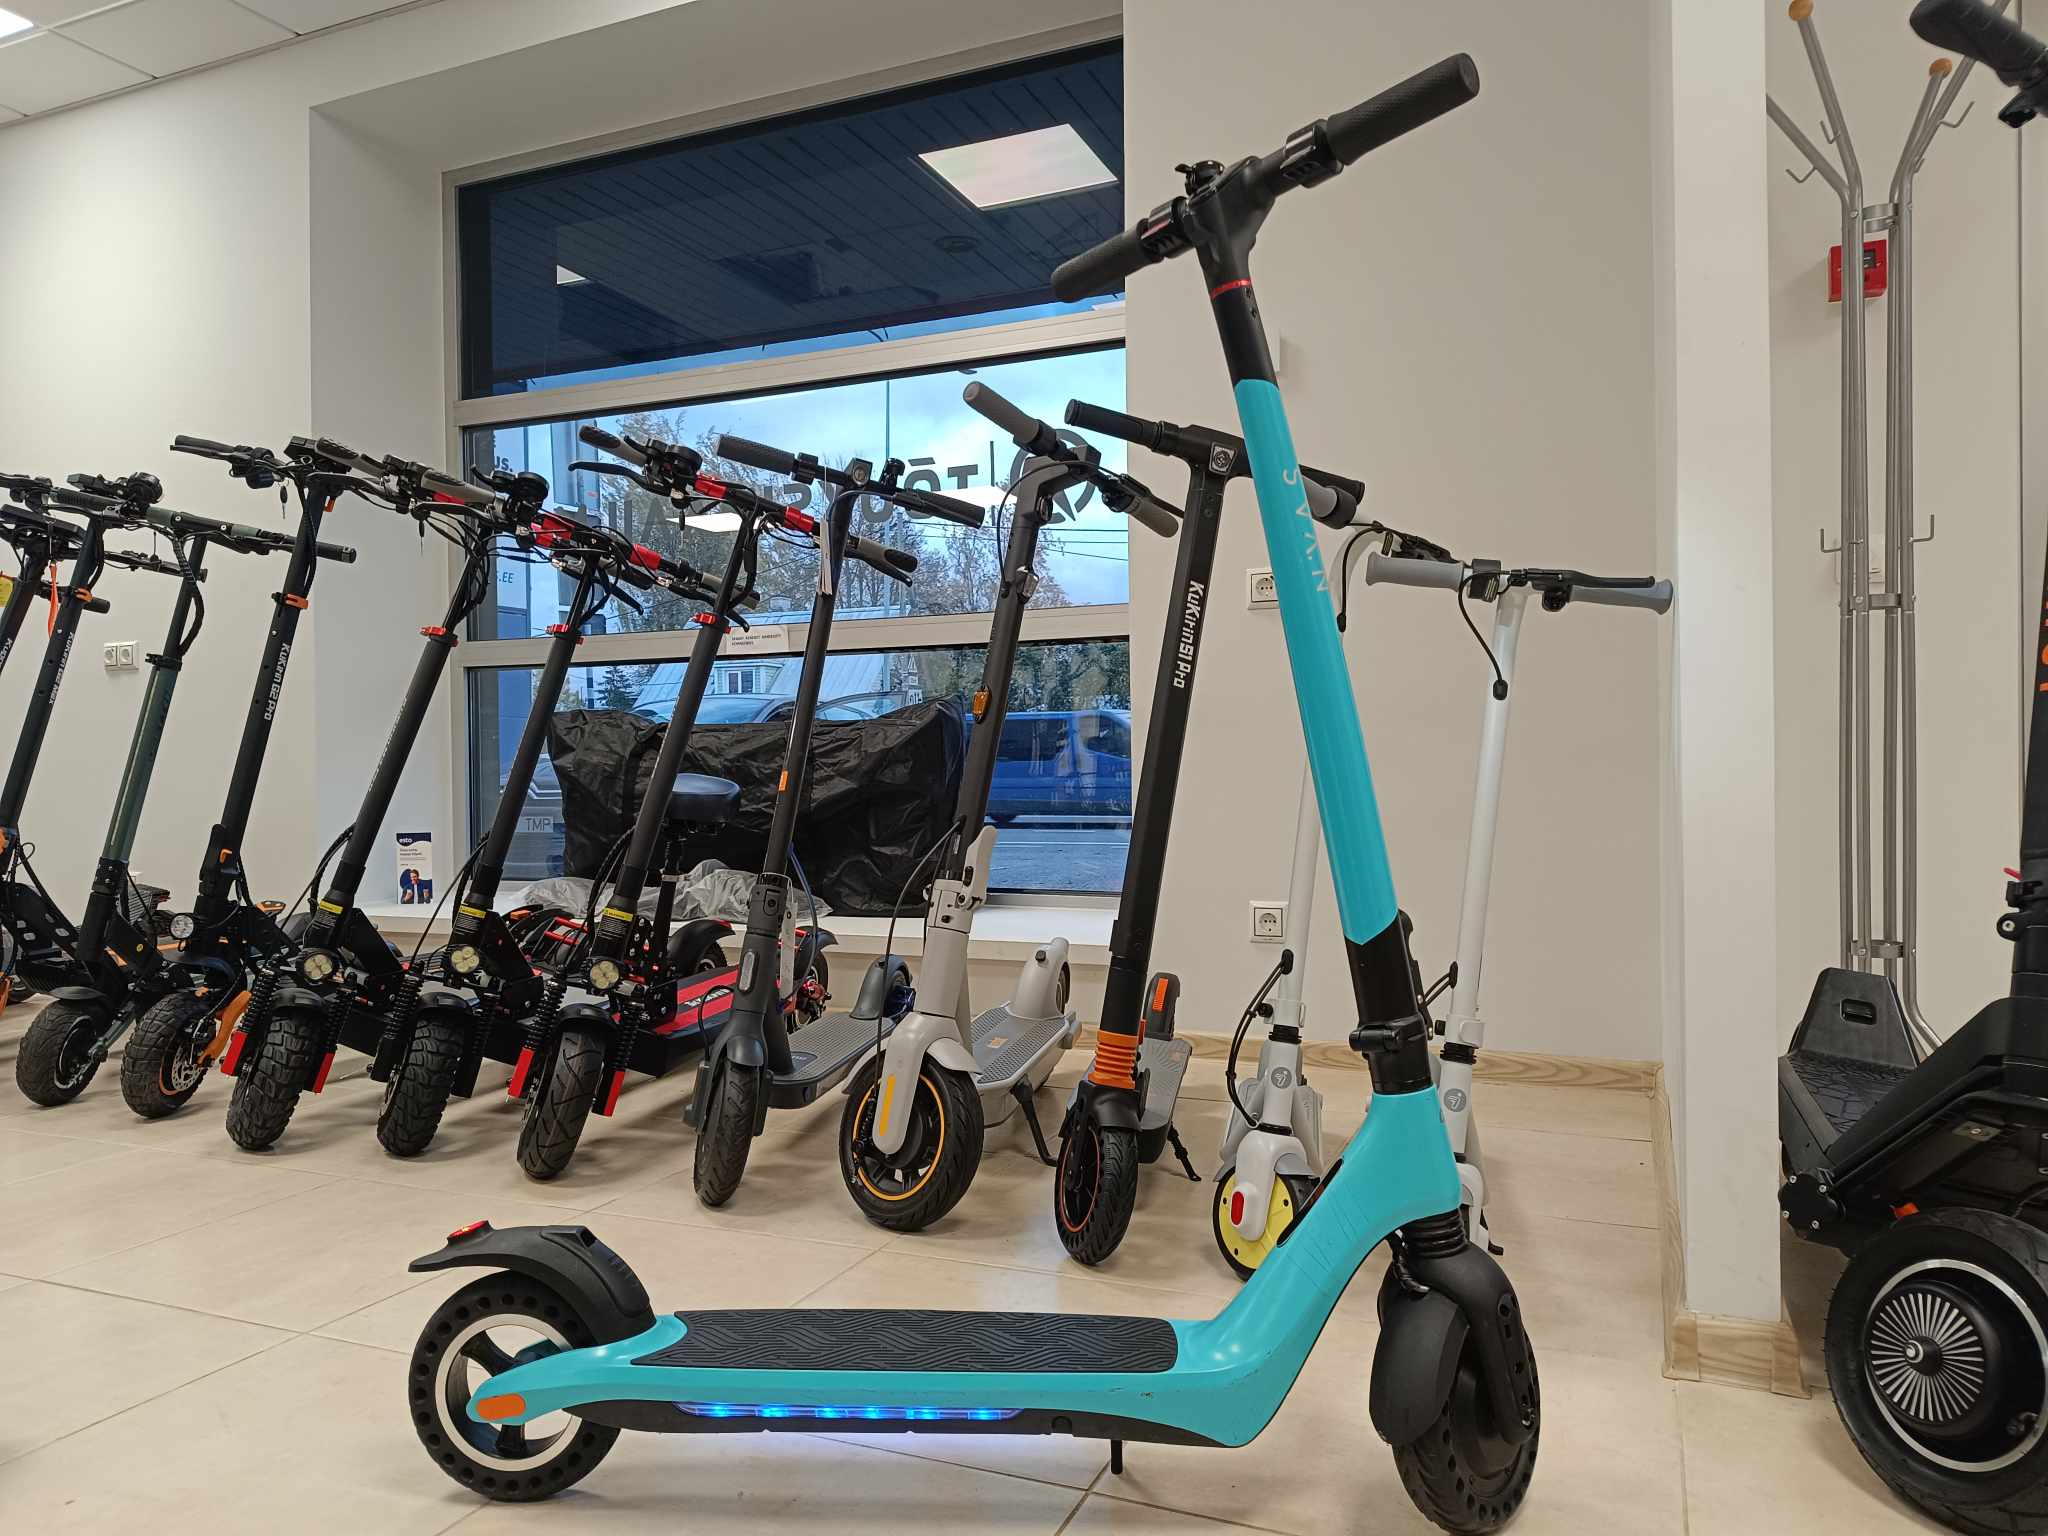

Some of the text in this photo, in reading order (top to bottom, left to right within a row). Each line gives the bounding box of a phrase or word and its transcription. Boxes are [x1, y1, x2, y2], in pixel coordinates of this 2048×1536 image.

[1174, 661, 1191, 688] Pro
[269, 683, 280, 700] G2
[264, 700, 276, 720] Pro
[525, 817, 551, 831] TMP
